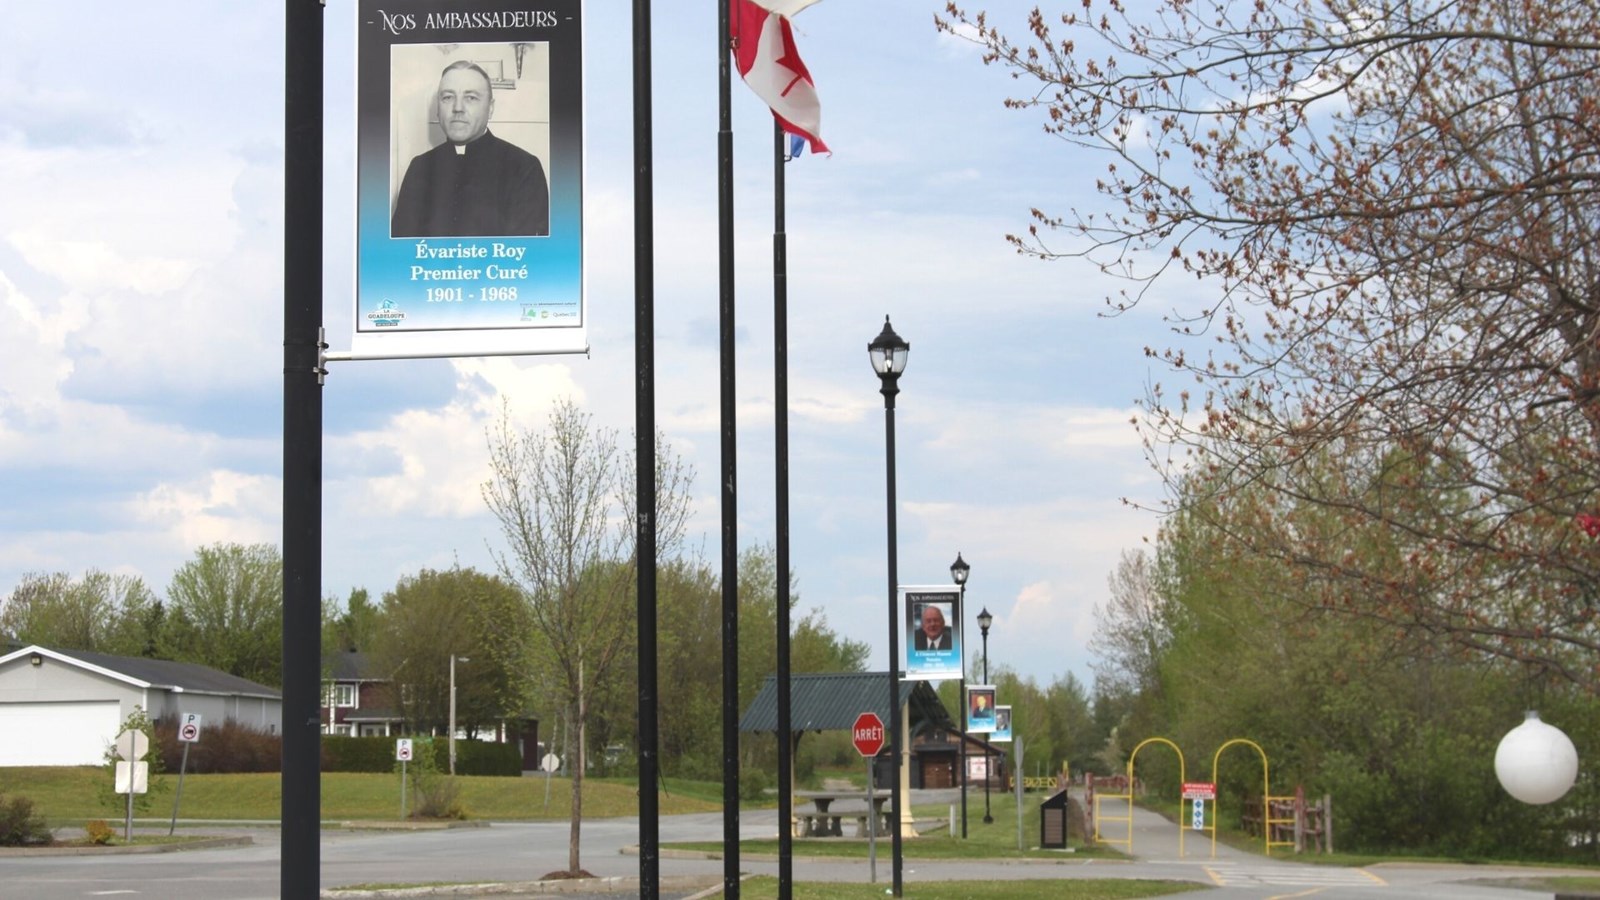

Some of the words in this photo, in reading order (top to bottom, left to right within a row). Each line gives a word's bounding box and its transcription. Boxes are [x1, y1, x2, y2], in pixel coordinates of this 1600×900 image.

[377, 10, 416, 35] NOS
[425, 10, 558, 29] AMBASSADEURS
[415, 240, 488, 258] Évariste
[492, 243, 527, 261] Roy
[410, 265, 481, 281] Premier
[486, 265, 528, 280] Curé
[426, 288, 464, 302] 1901
[479, 287, 518, 301] 1968
[187, 714, 195, 724] P
[855, 725, 882, 741] ARRÊT
[401, 740, 408, 748] P
